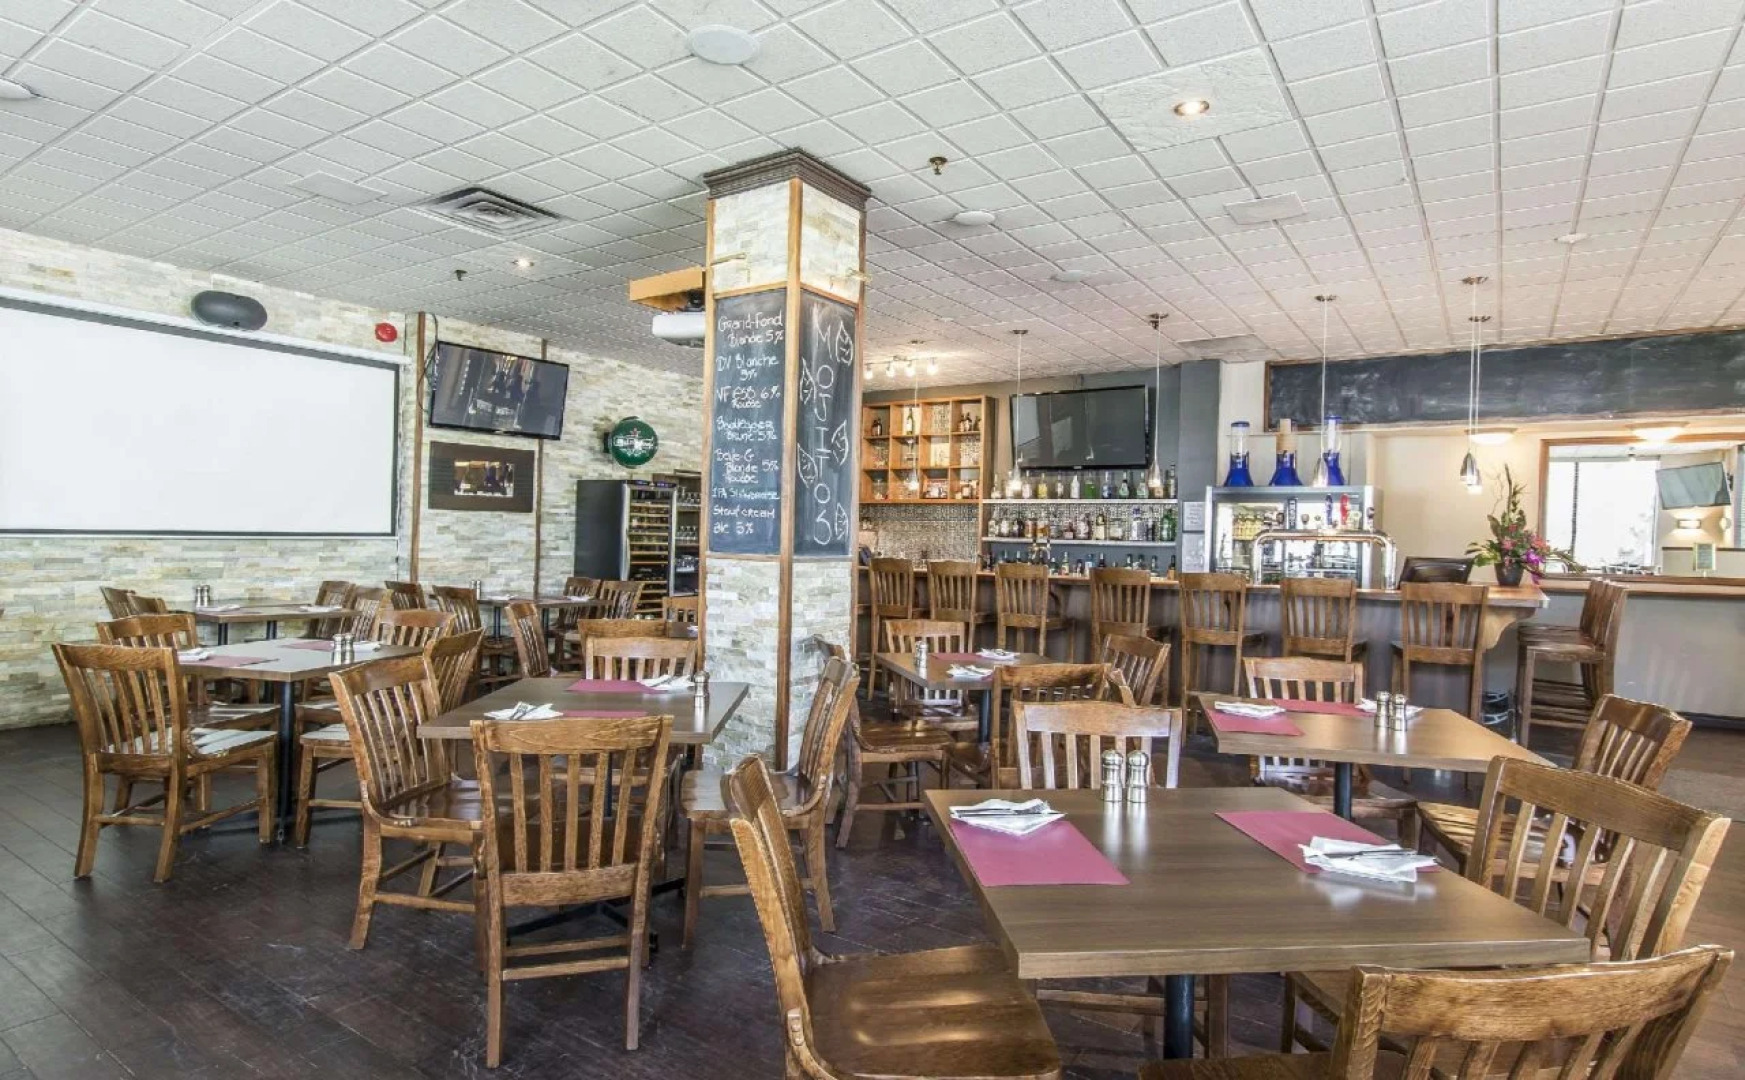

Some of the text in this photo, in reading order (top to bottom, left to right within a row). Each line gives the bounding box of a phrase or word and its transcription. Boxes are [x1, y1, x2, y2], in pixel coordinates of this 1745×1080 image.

[814, 304, 834, 545] MOJITOS
[762, 459, 780, 473] 5%
[735, 521, 755, 536] 5%
